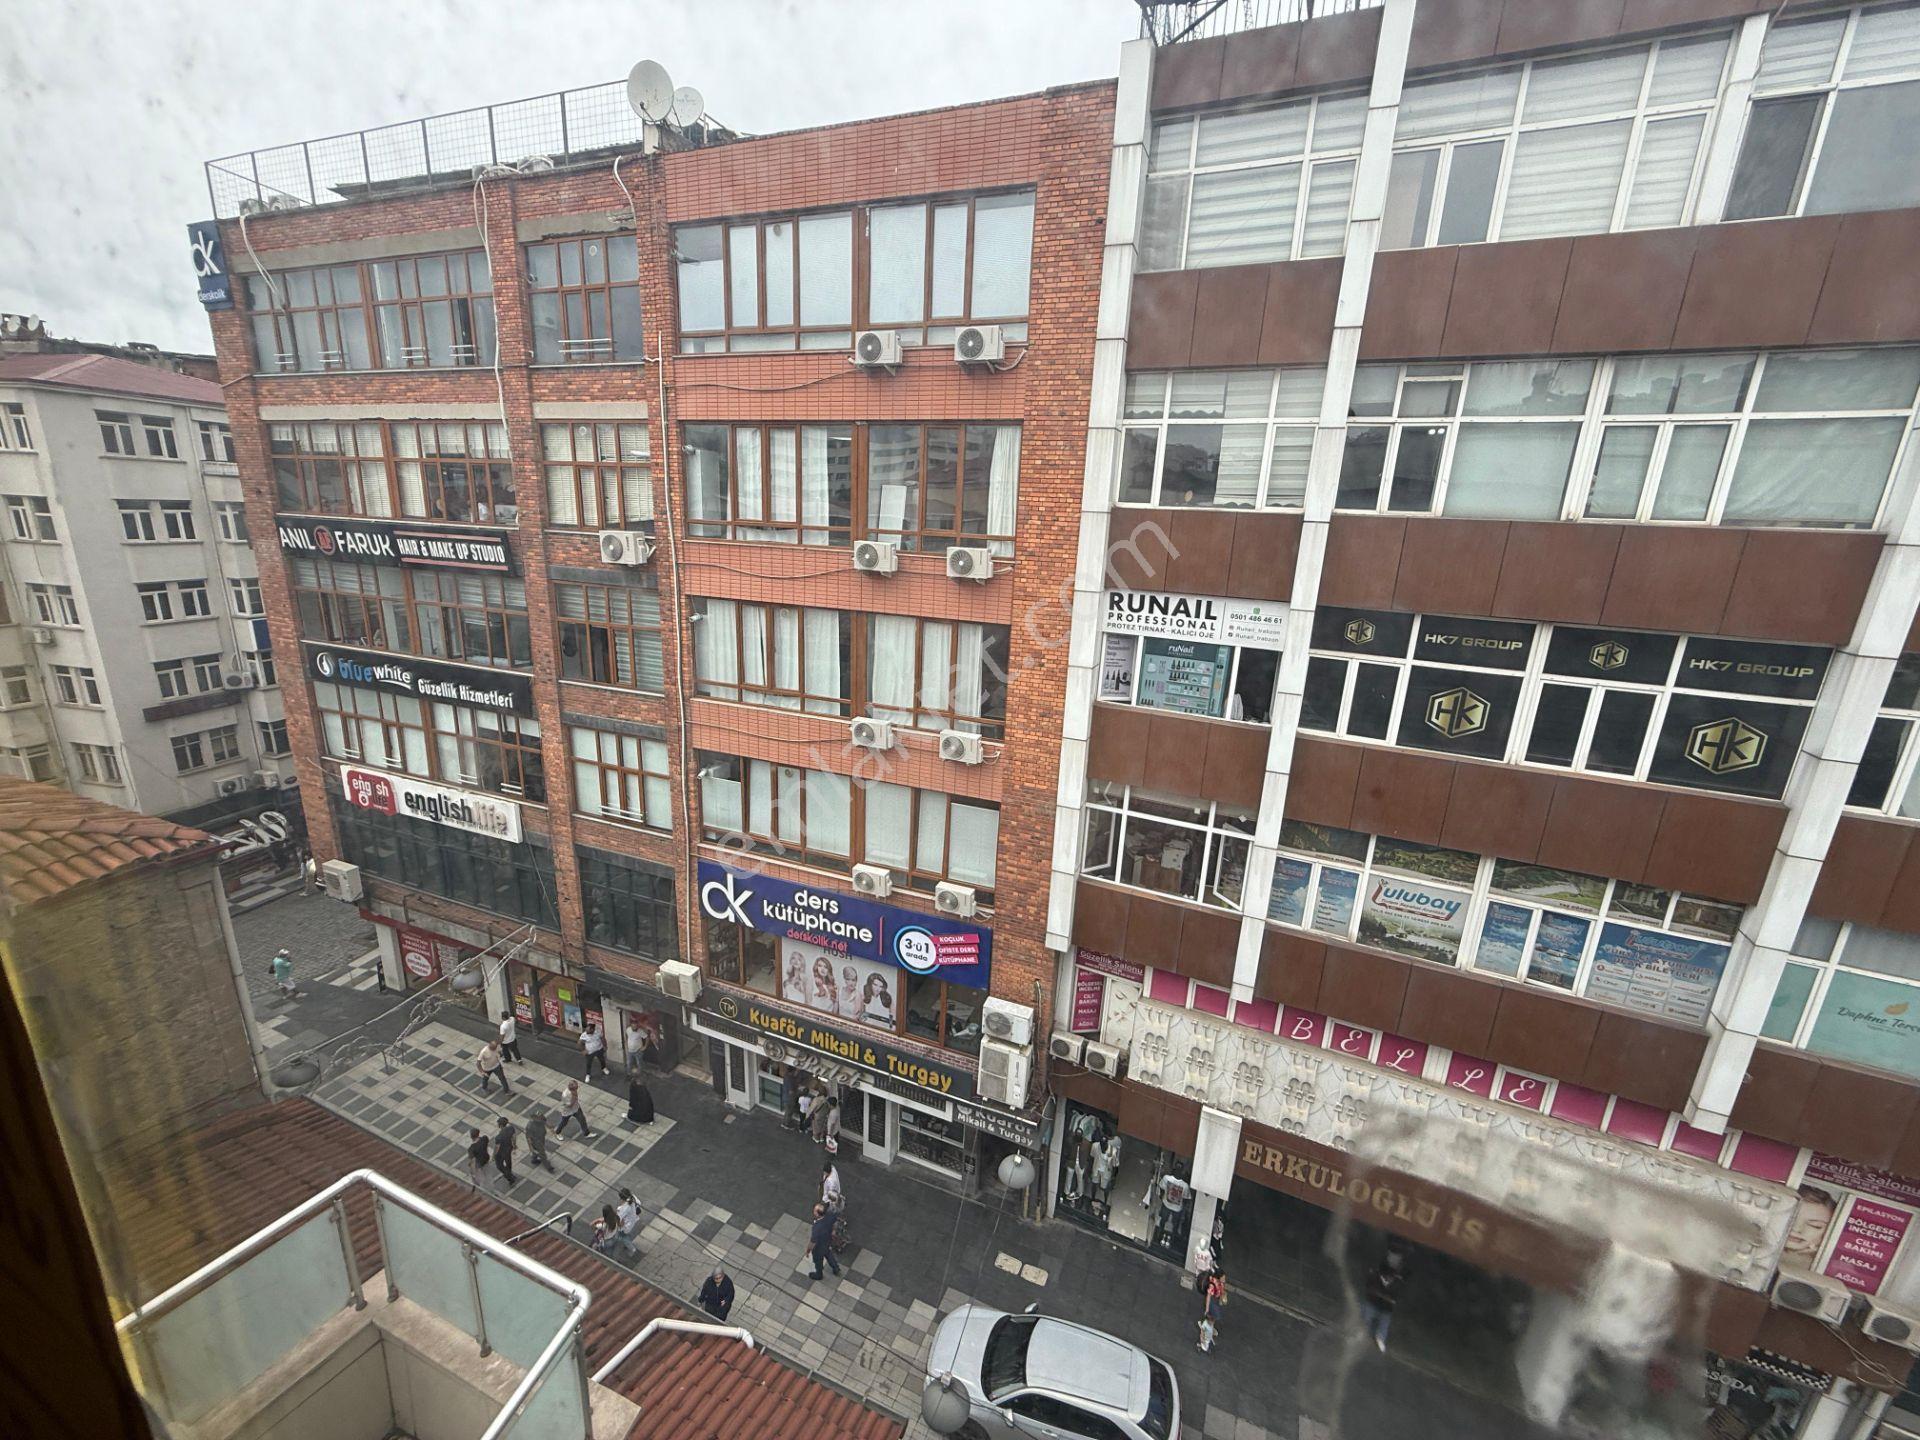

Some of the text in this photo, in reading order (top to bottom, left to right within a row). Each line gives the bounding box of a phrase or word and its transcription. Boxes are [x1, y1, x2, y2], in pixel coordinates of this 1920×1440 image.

[279, 527, 316, 550] ANIL
[334, 530, 395, 557] FARUK
[397, 539, 420, 556] HAIR
[420, 540, 429, 556] &
[428, 541, 456, 559] MAKE
[455, 542, 469, 560] UP
[470, 543, 506, 563] STUDIO
[1109, 591, 1218, 621] RUNAIL
[1107, 612, 1216, 632] PROFESSIONAL
[1107, 622, 1137, 632] PROTEZ
[1424, 633, 1524, 651] HK7 GROUP
[1689, 658, 1815, 678] HK7 GROUP
[417, 678, 458, 699] Güzellik
[459, 684, 514, 709] Hizmetleri
[794, 889, 839, 915] ders
[1383, 887, 1462, 914] ulubay
[763, 899, 874, 943] kütüphane
[905, 950, 929, 962] arada
[749, 1007, 953, 1093] Kuaför Mikail & Turgay
[957, 1112, 986, 1129] Mikail
[998, 1126, 1033, 1147] Turgay
[1810, 1158, 1862, 1181] üzellik
[1839, 1254, 1877, 1271] MASAJ
